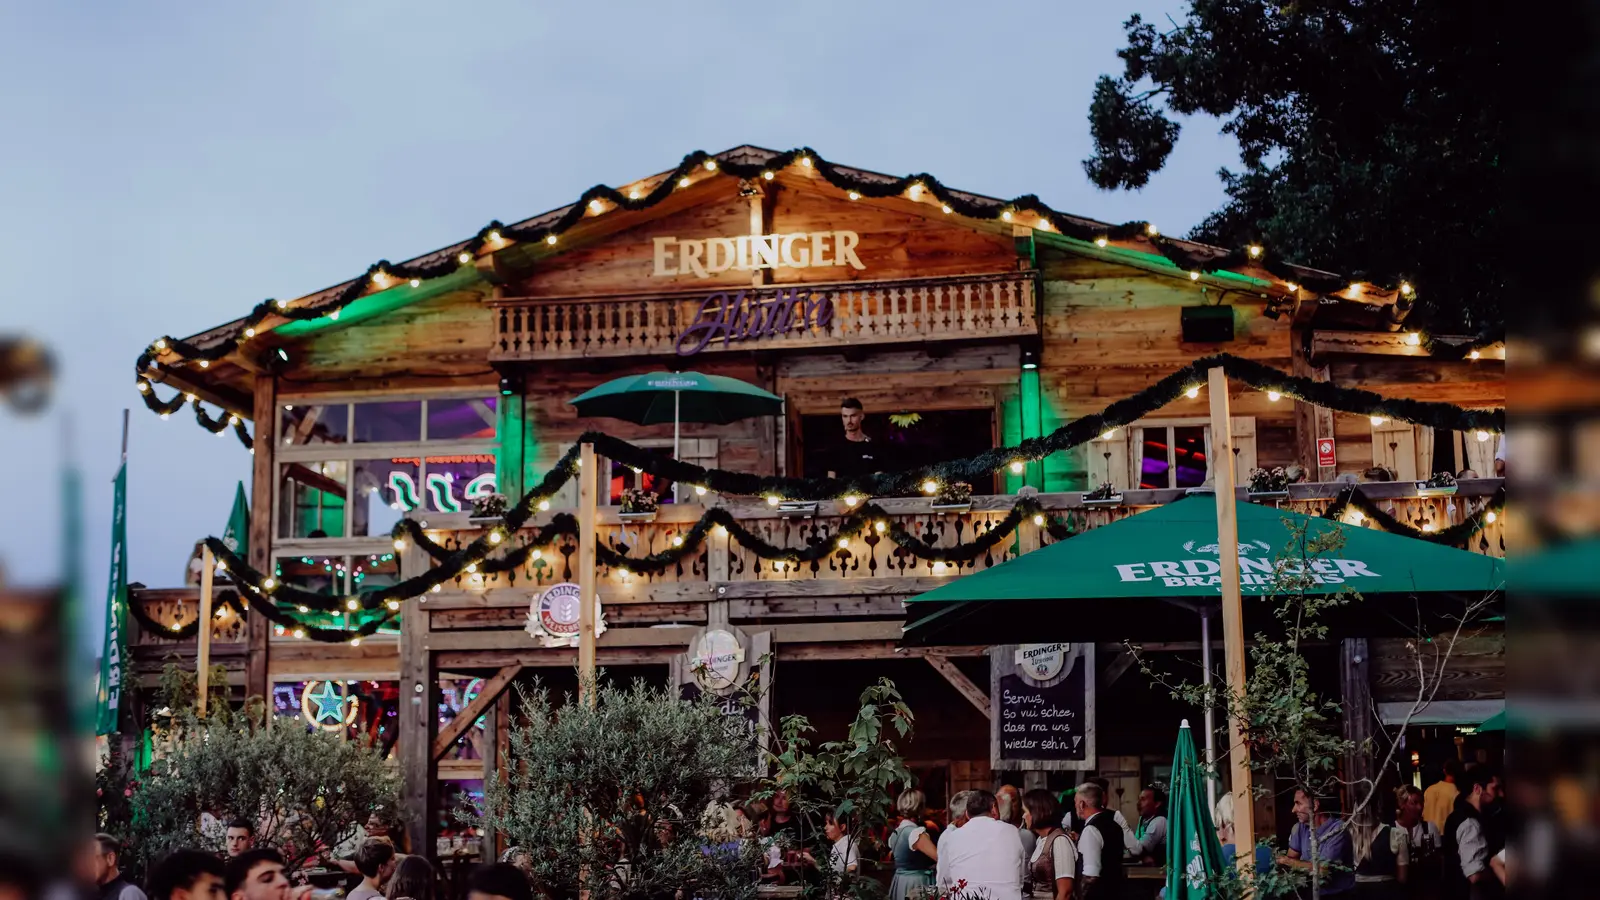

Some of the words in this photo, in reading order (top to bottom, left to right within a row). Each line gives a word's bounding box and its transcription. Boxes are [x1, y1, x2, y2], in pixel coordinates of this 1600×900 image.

[652, 230, 866, 279] ERDINGER
[1114, 557, 1382, 582] ERDNGER
[543, 586, 580, 606] ERDING
[1023, 643, 1062, 659] ERDINGER
[1003, 689, 1045, 705] Servus,
[1020, 705, 1039, 718] vui
[1041, 704, 1075, 718] schee,
[1003, 722, 1026, 732] dass
[1031, 724, 1048, 732] ma
[1052, 723, 1070, 732] uns
[1004, 737, 1038, 749] wieder
